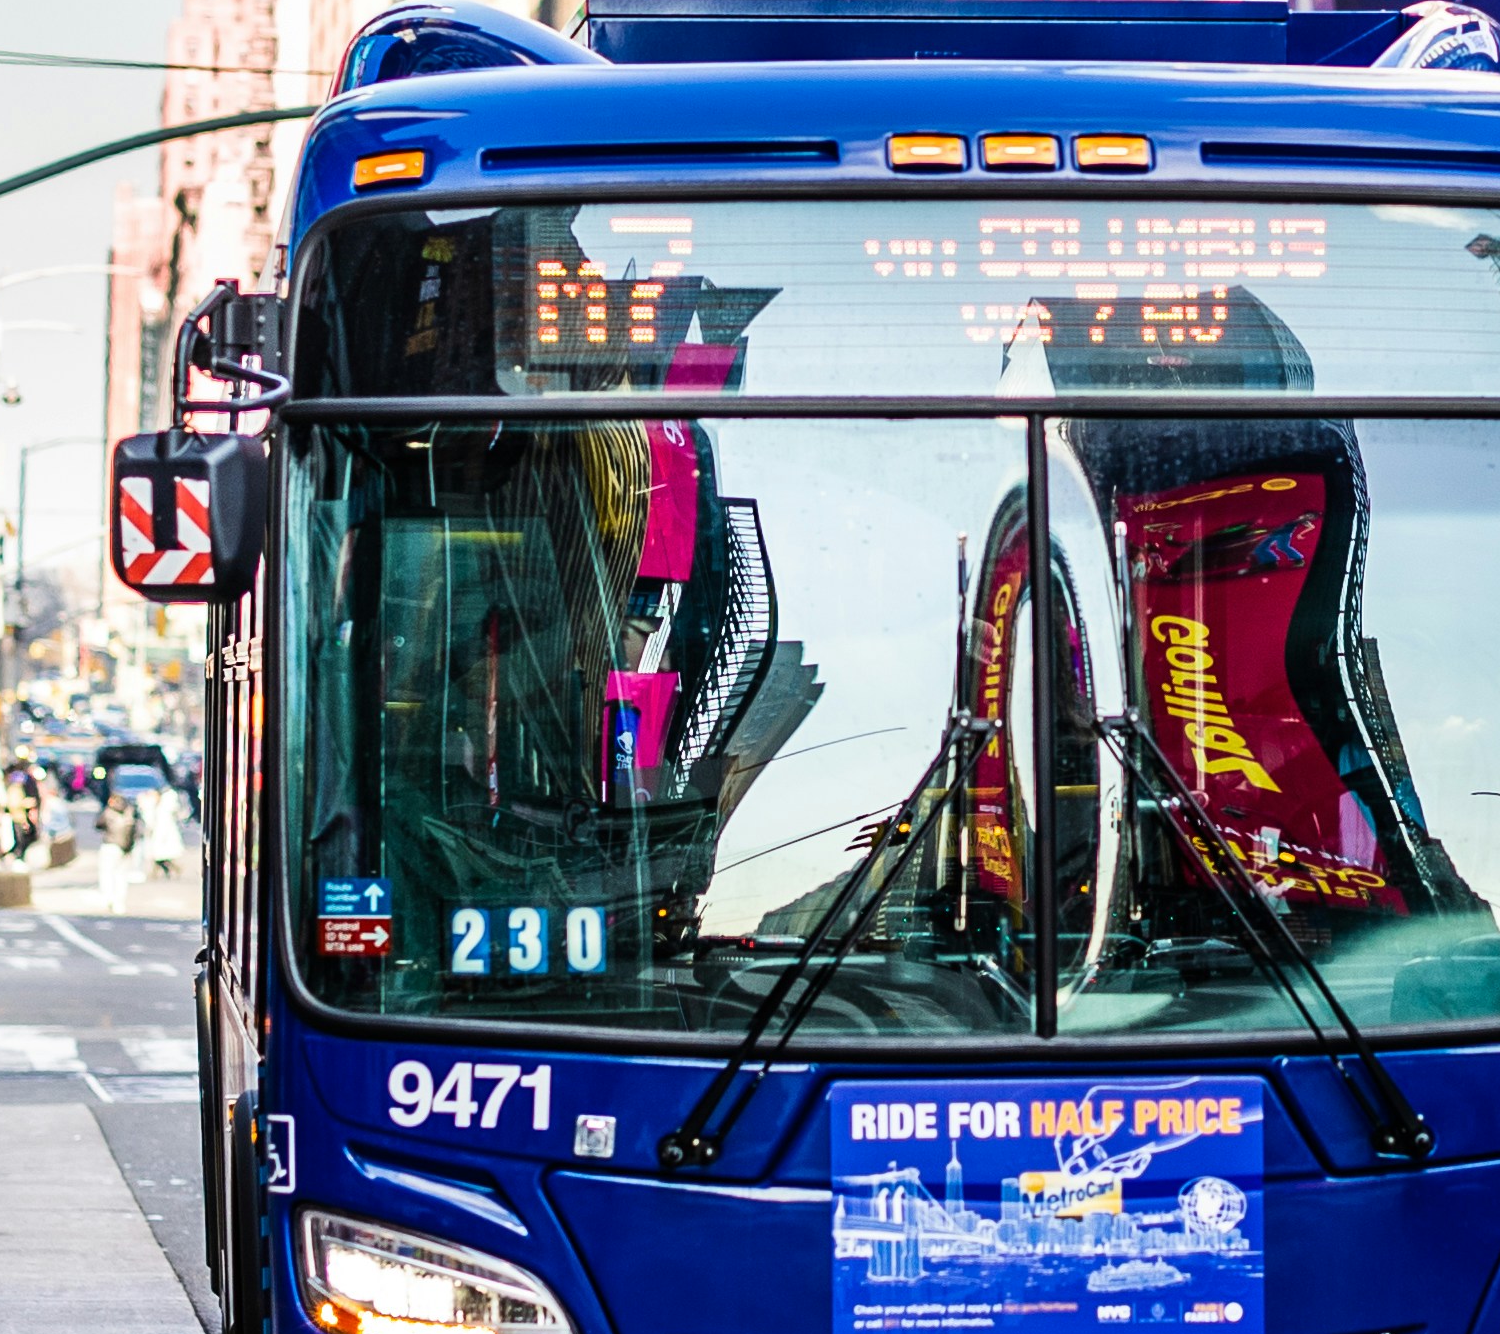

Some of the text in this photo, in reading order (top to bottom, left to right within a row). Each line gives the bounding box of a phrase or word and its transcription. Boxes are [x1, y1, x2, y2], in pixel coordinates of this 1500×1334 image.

[980, 217, 1326, 278] COLUMBUS
[324, 920, 360, 932] Control
[387, 1059, 553, 1131] 9471
[851, 1098, 1242, 1140] RIDE FOR HALF PRICE
